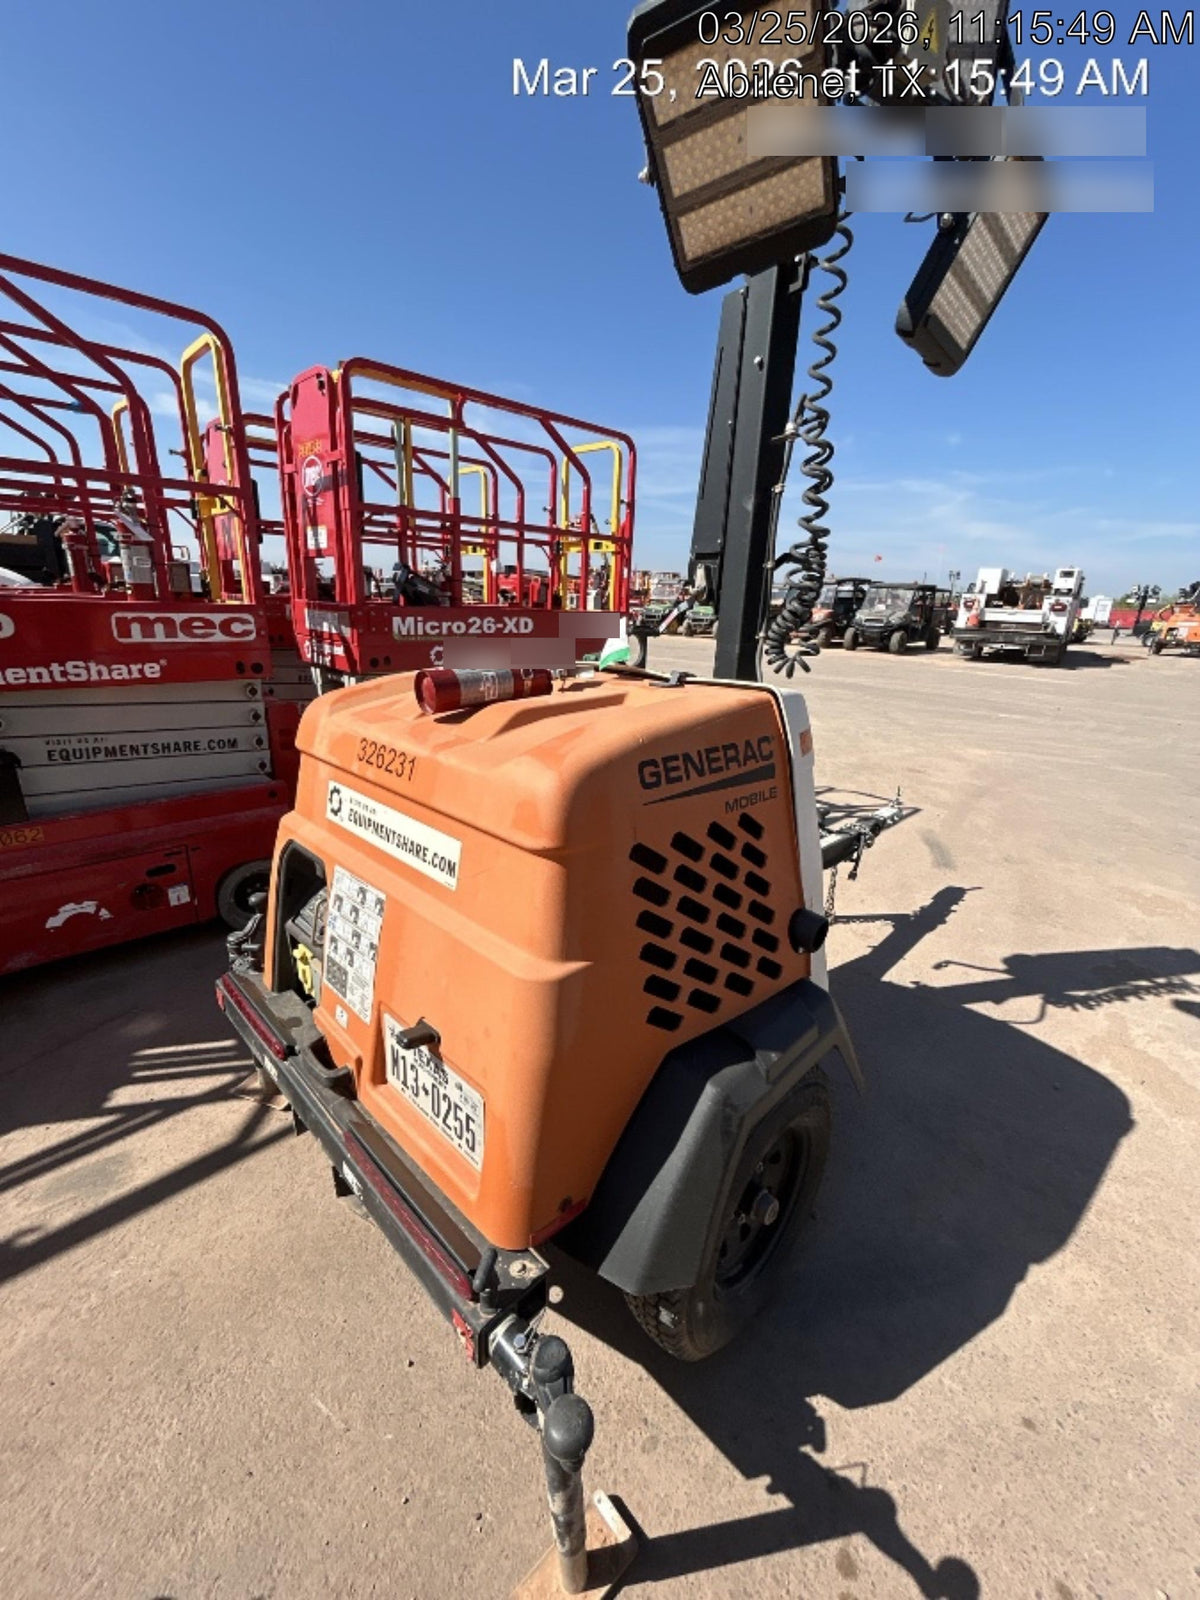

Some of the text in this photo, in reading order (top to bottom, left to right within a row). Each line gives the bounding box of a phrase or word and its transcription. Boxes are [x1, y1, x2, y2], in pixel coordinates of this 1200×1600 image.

[114, 614, 255, 640] mec
[391, 616, 534, 636] Micro26-XD
[47, 738, 239, 762] EQUIPMENTSHARE.COM
[357, 737, 418, 782] 326231
[637, 735, 774, 790] GENERAC
[725, 786, 778, 814] MOBILE
[347, 808, 457, 879] EQUIPMENTSHARE.COM
